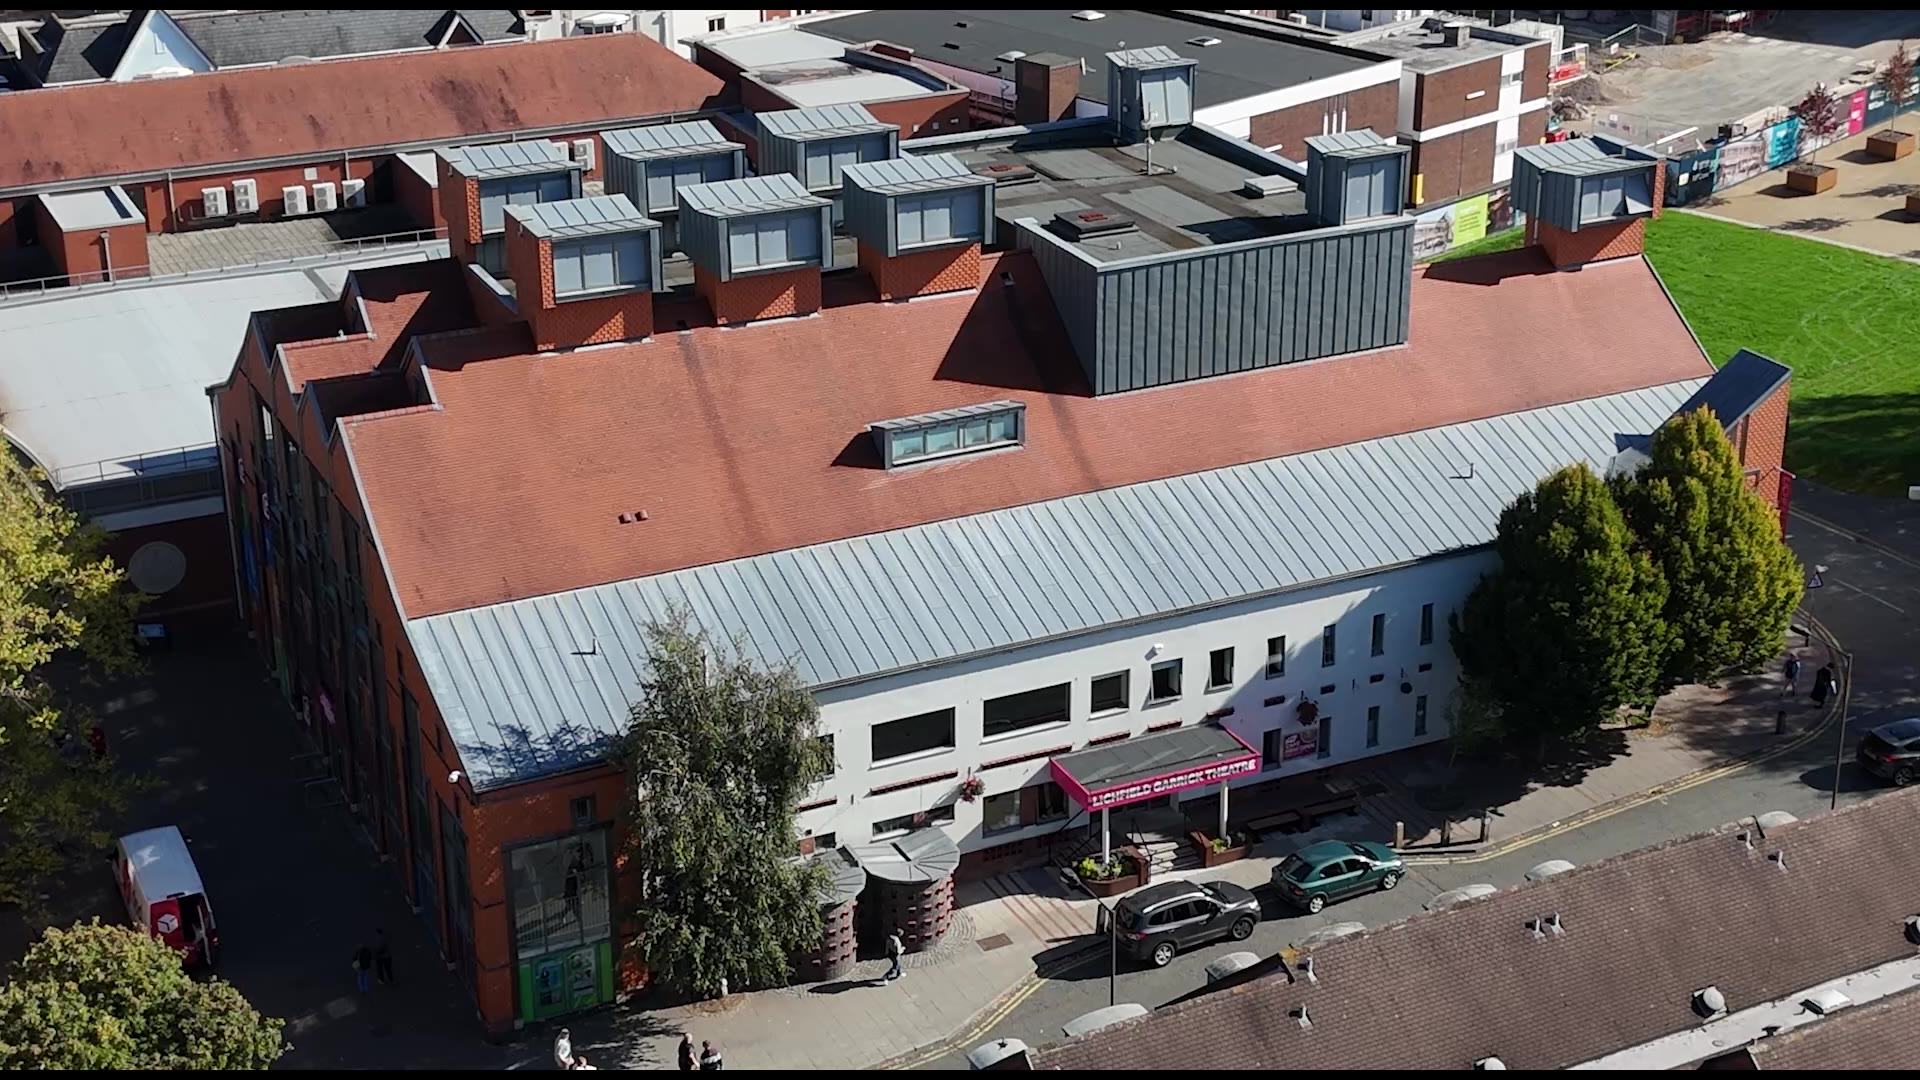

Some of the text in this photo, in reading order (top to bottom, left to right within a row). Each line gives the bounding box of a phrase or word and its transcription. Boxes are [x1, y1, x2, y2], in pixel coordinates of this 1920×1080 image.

[1092, 759, 1256, 807] LICHFIELD GARRICK THEATRE
